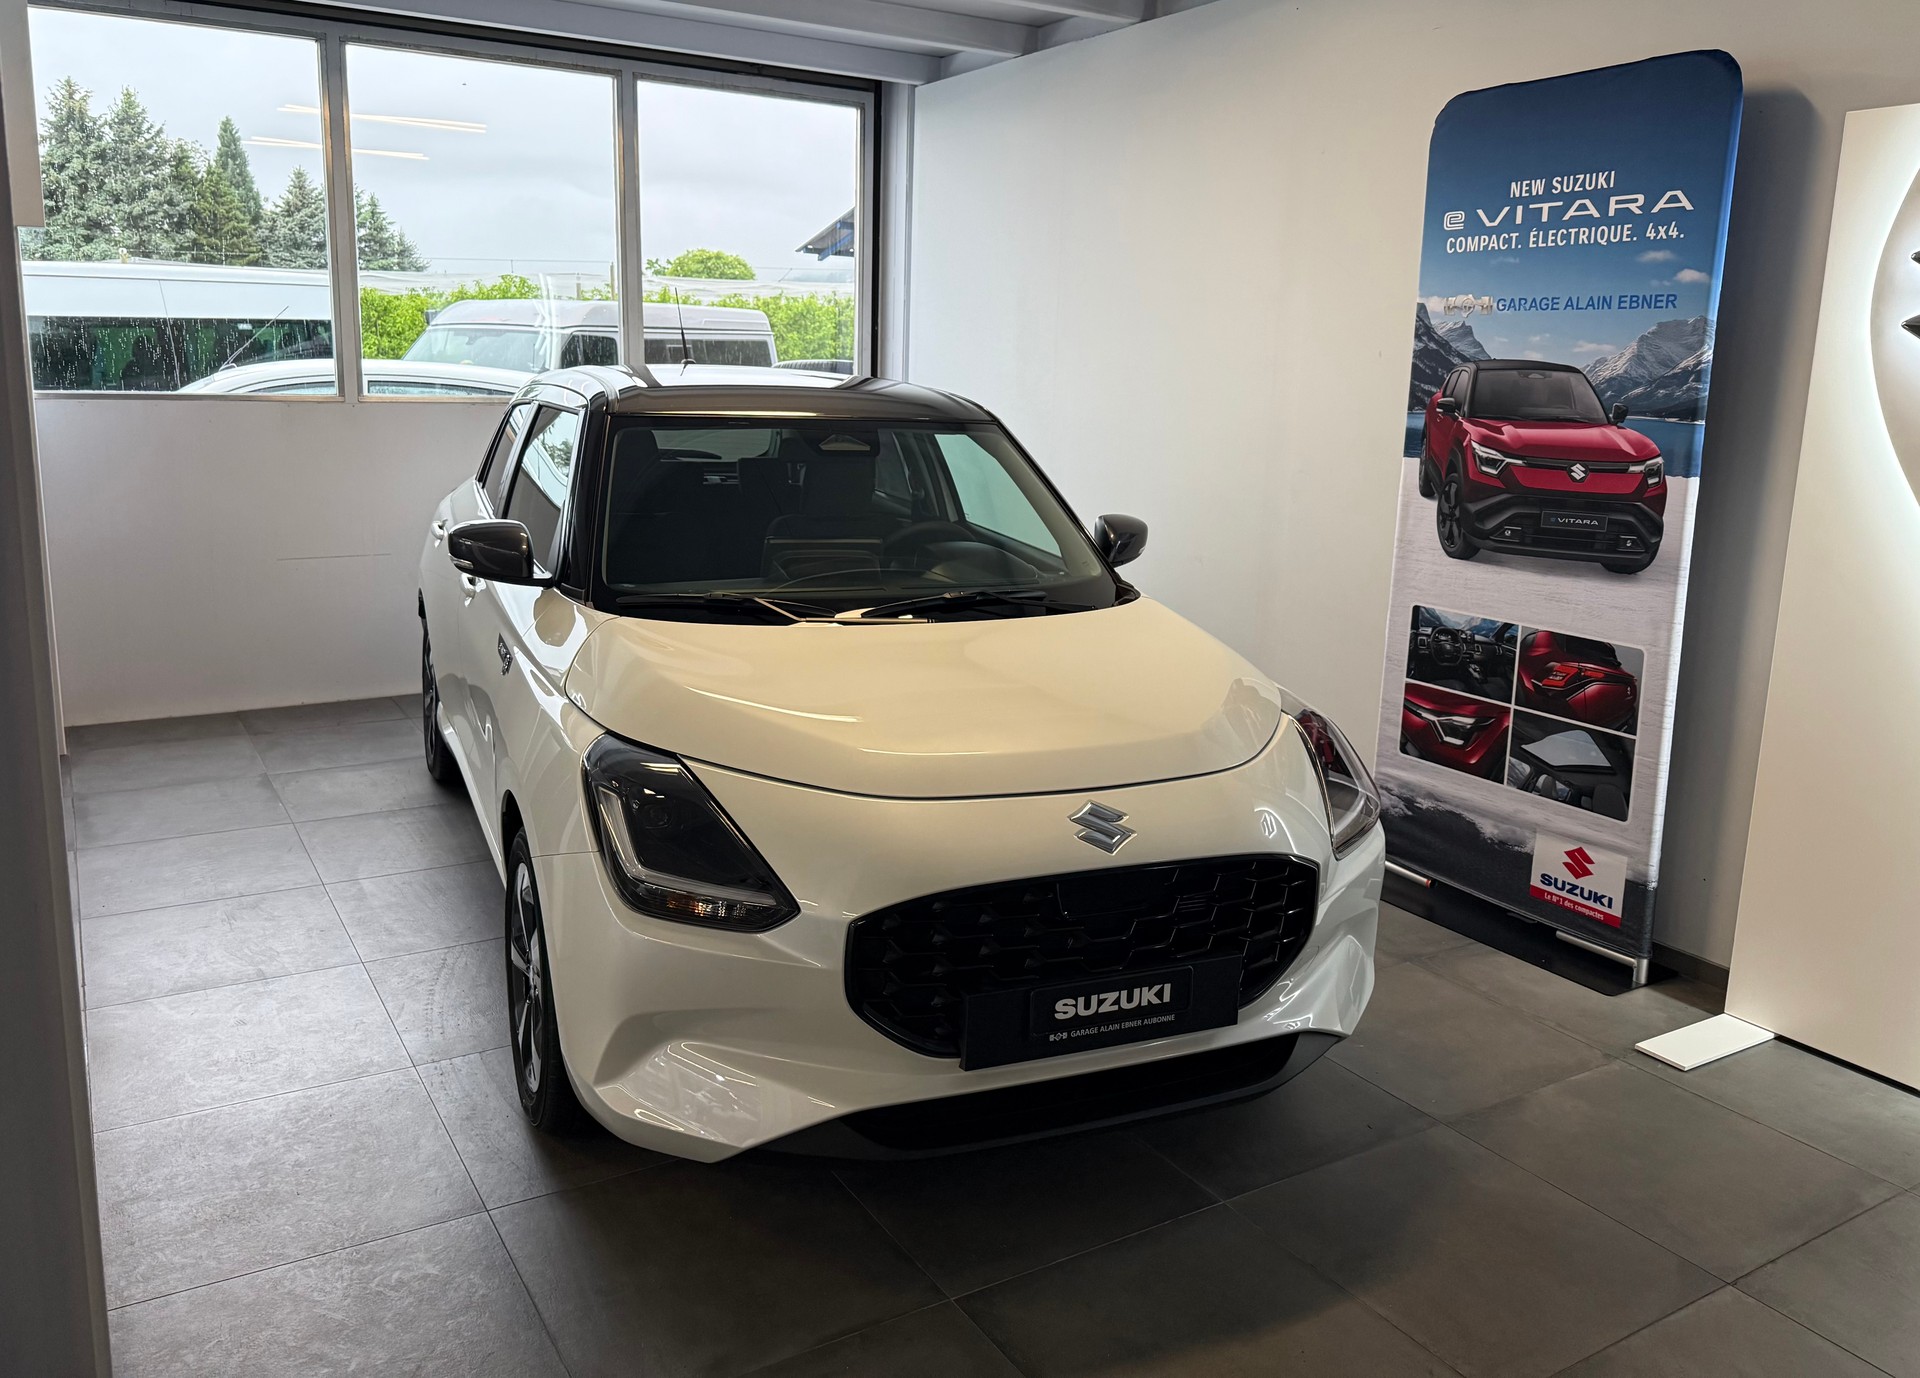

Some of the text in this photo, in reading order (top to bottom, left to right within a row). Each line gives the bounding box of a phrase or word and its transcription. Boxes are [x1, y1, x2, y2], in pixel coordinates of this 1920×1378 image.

[1510, 170, 1616, 198] NEW SUZUKI
[1446, 220, 1685, 253] COMPACT. ÉLECTRIQUE. 4x4.
[1496, 293, 1678, 312] GARAGE ALAIN EBNER
[1540, 873, 1614, 909] SUZUKI
[1544, 892, 1552, 901] Le
[1564, 899, 1574, 909] des
[1574, 904, 1605, 921] compactes
[1054, 983, 1172, 1020] SUZUKI
[1070, 1013, 1176, 1038] GARAGE ALAIN EBNER AUBONNE
